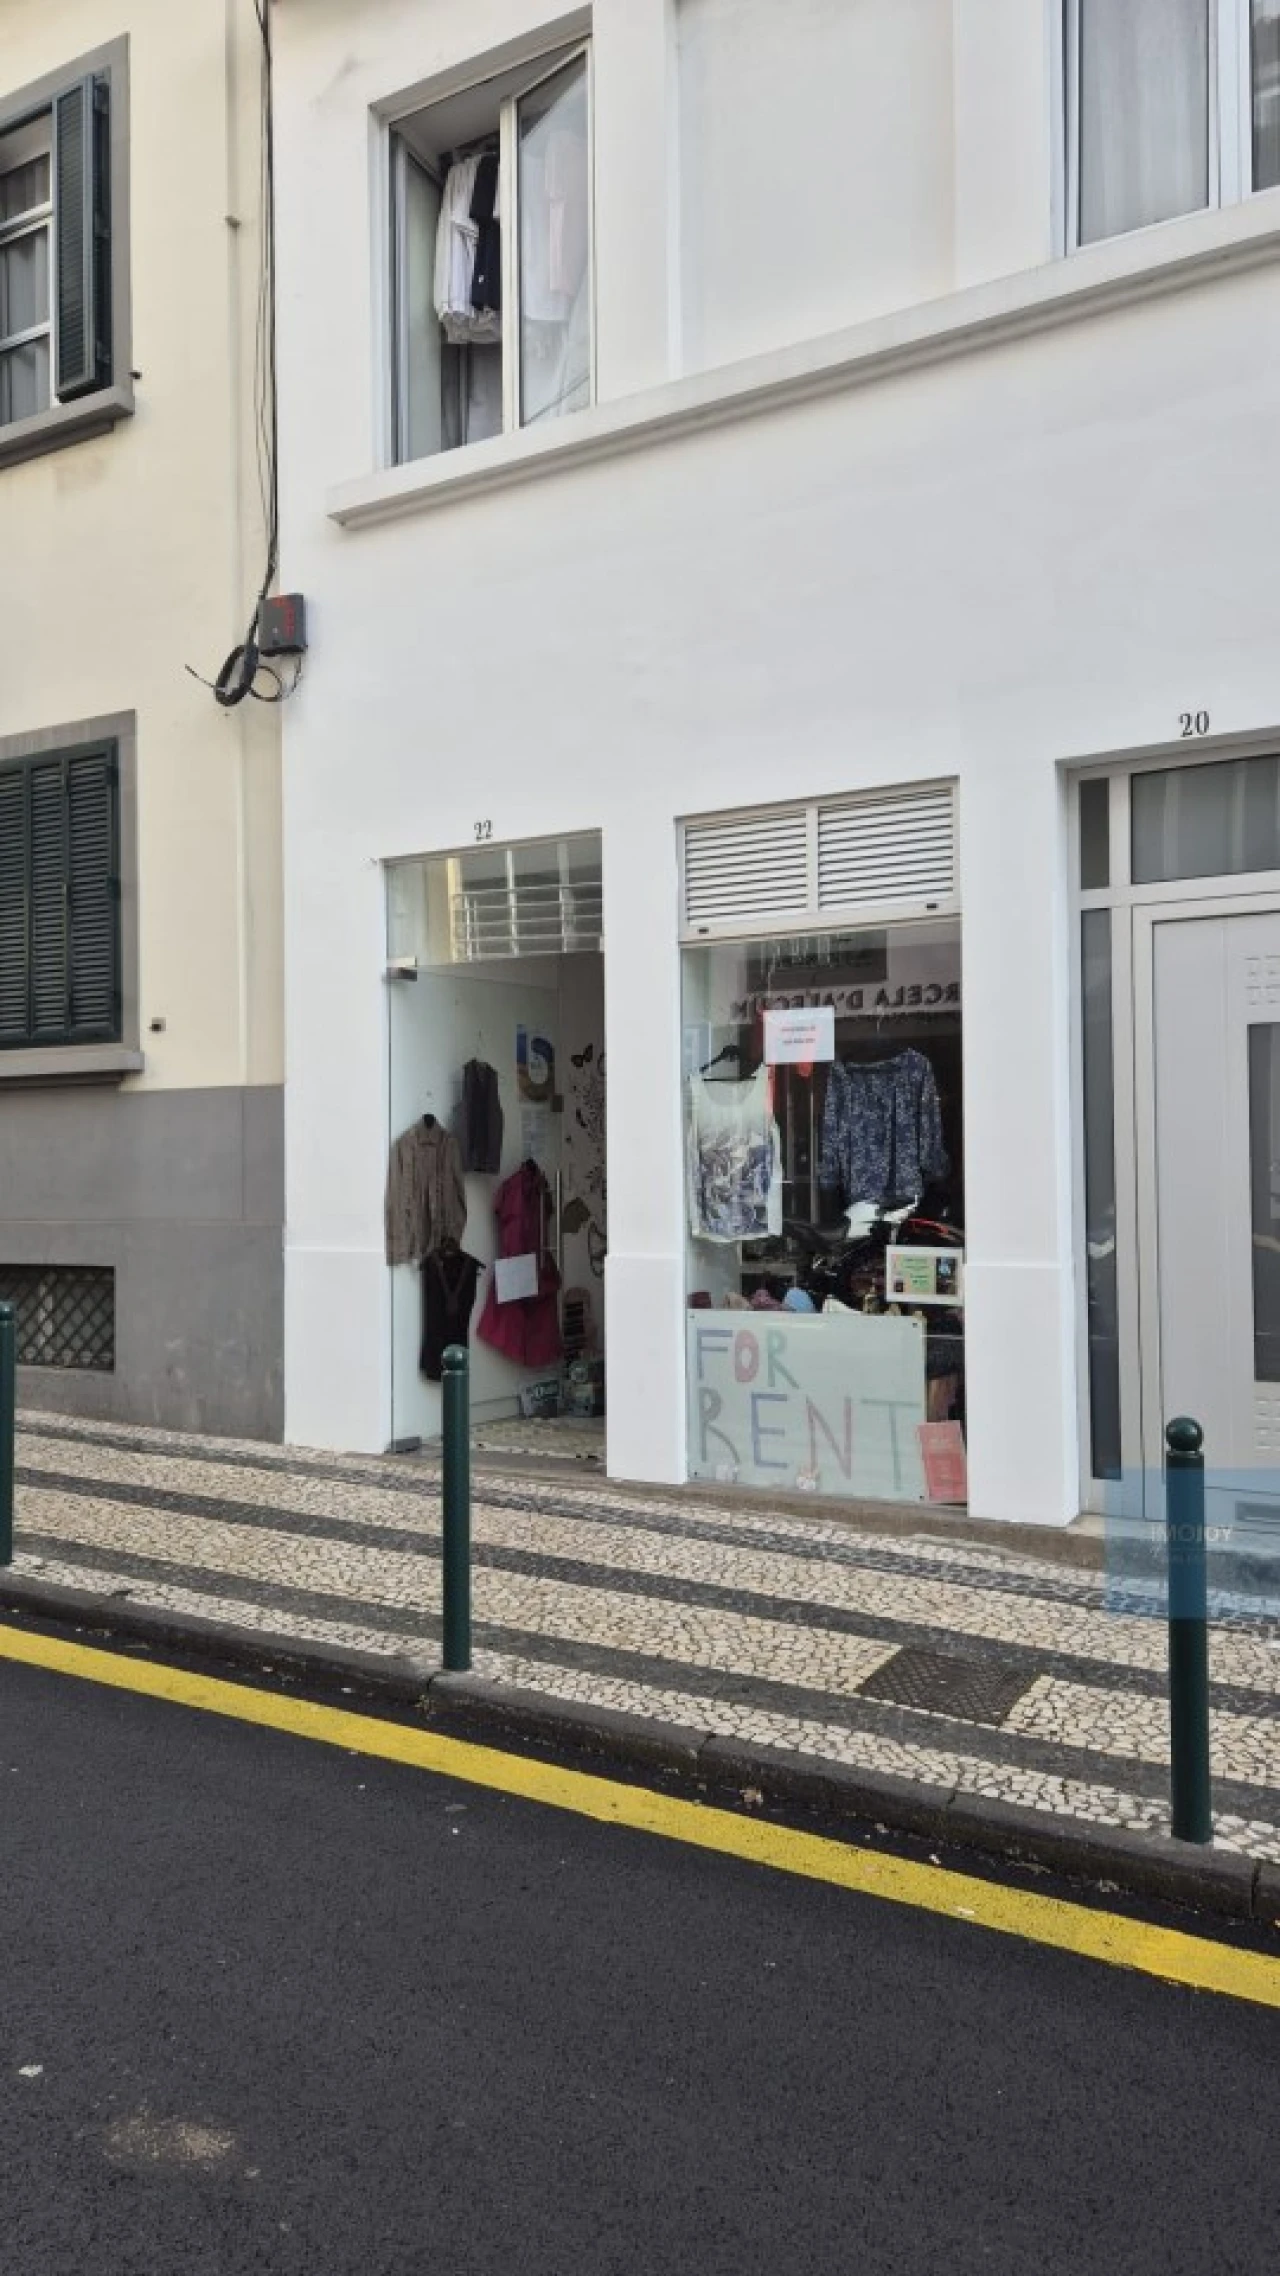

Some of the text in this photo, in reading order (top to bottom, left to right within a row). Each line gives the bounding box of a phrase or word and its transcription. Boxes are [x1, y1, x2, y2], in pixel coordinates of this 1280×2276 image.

[1178, 711, 1210, 738] 20
[473, 819, 494, 841] 22
[696, 1329, 799, 1389] FOR
[698, 1387, 920, 1492] RENT
